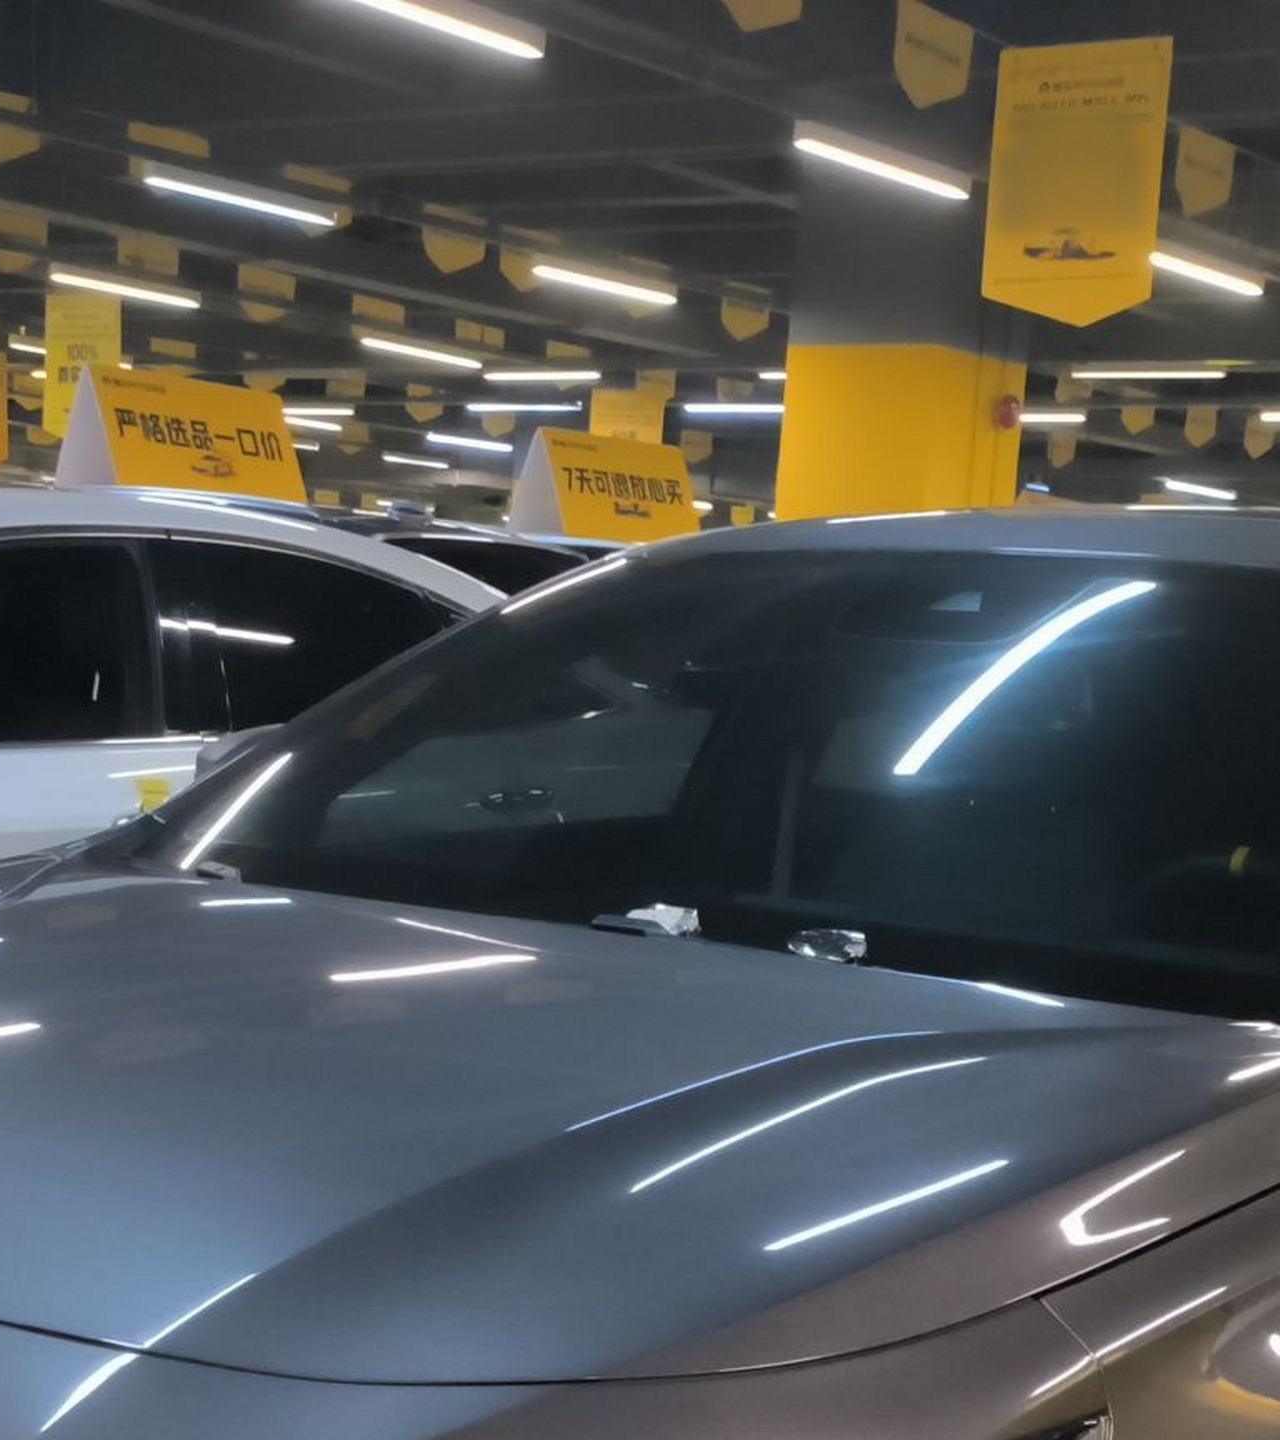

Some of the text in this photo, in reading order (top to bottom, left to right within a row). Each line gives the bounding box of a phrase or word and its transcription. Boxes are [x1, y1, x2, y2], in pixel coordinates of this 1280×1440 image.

[114, 407, 283, 461] 严格选品一口价
[562, 466, 684, 506] 7天可退放心买
